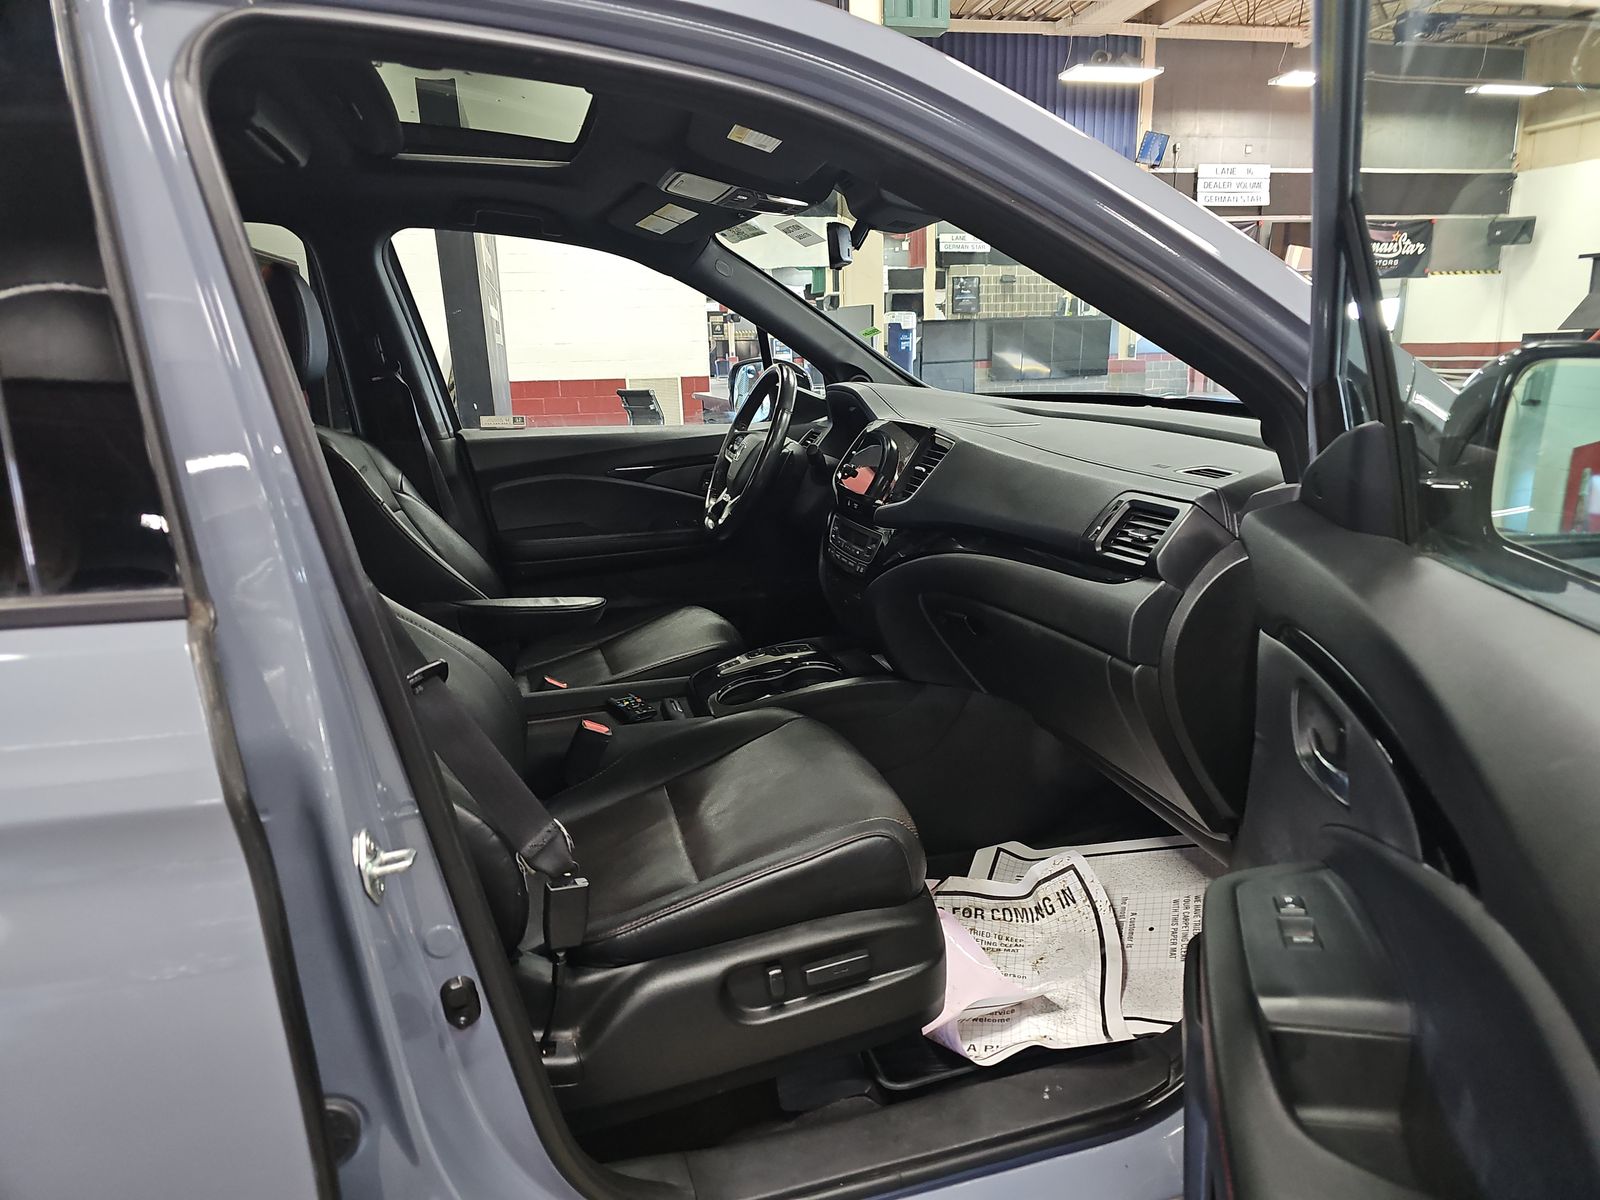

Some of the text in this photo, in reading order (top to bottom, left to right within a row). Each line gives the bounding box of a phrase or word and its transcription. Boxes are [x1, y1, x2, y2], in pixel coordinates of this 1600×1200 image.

[1215, 167, 1237, 175] LANE
[1203, 181, 1262, 189] DEALER VOLUME
[1203, 195, 1238, 203] GERMAN
[952, 886, 1077, 923] FOR COMING IN
[1183, 895, 1191, 911] YOUR
[1192, 894, 1202, 936] WE HAVE TRIED
[968, 927, 991, 938] TRIED
[993, 933, 1004, 941] TO
[1126, 917, 1136, 942] customer
[1168, 898, 1180, 959] WITH THIS PAPER MAT
[1180, 911, 1191, 942] CARPETING
[966, 1043, 977, 1052] A
